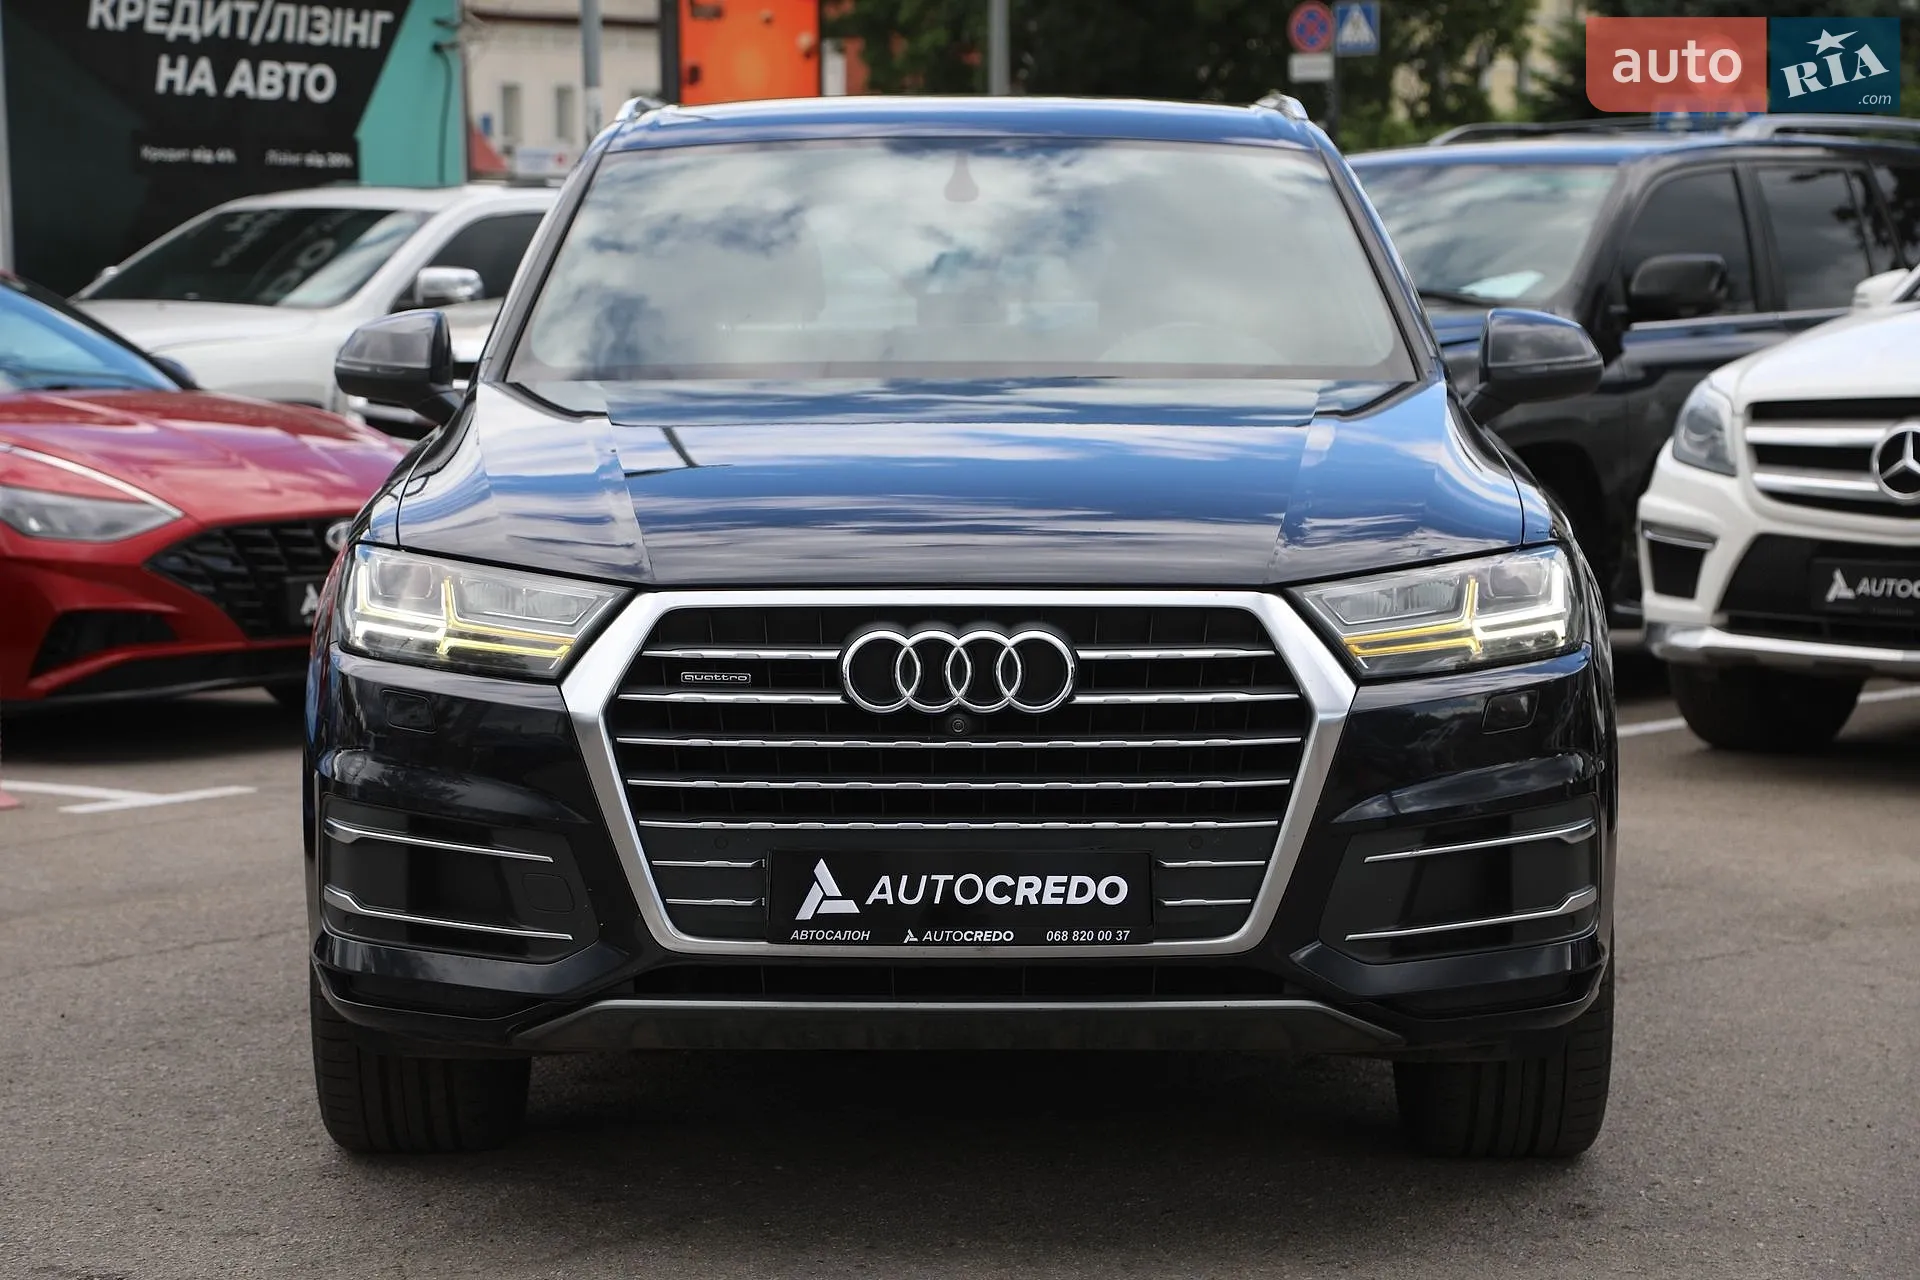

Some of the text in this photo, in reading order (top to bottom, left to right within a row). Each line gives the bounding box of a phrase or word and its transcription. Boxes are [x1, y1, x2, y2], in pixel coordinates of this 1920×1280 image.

[87, 0, 394, 49] КРЕДИТ/ЛІЗІНГ
[155, 54, 336, 103] НА АВТО
[865, 874, 1129, 906] AUTOCREDO
[790, 930, 871, 941] АВТОСАЛОН
[922, 930, 1014, 942] AUTOCREDO
[1046, 930, 1131, 942] 068 820 00 37
